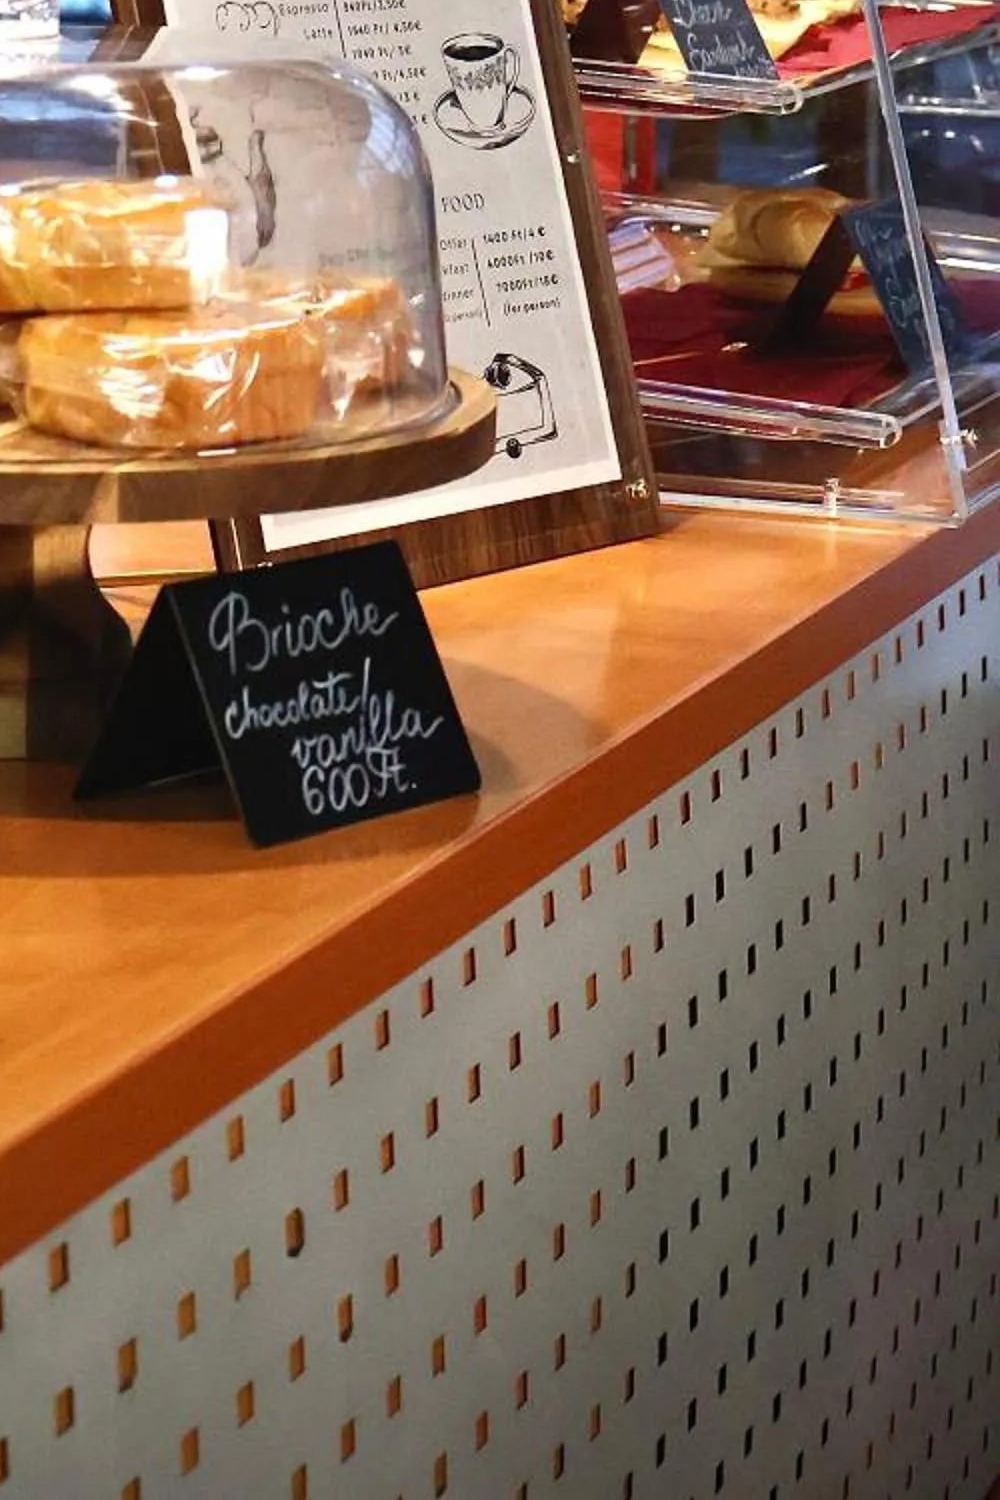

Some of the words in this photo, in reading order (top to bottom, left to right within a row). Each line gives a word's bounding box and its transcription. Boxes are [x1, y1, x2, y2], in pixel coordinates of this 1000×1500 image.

[279, 2, 330, 17] Espresso
[440, 192, 485, 213] FOOD
[208, 586, 399, 676] Brioche
[290, 689, 445, 768] vanilla
